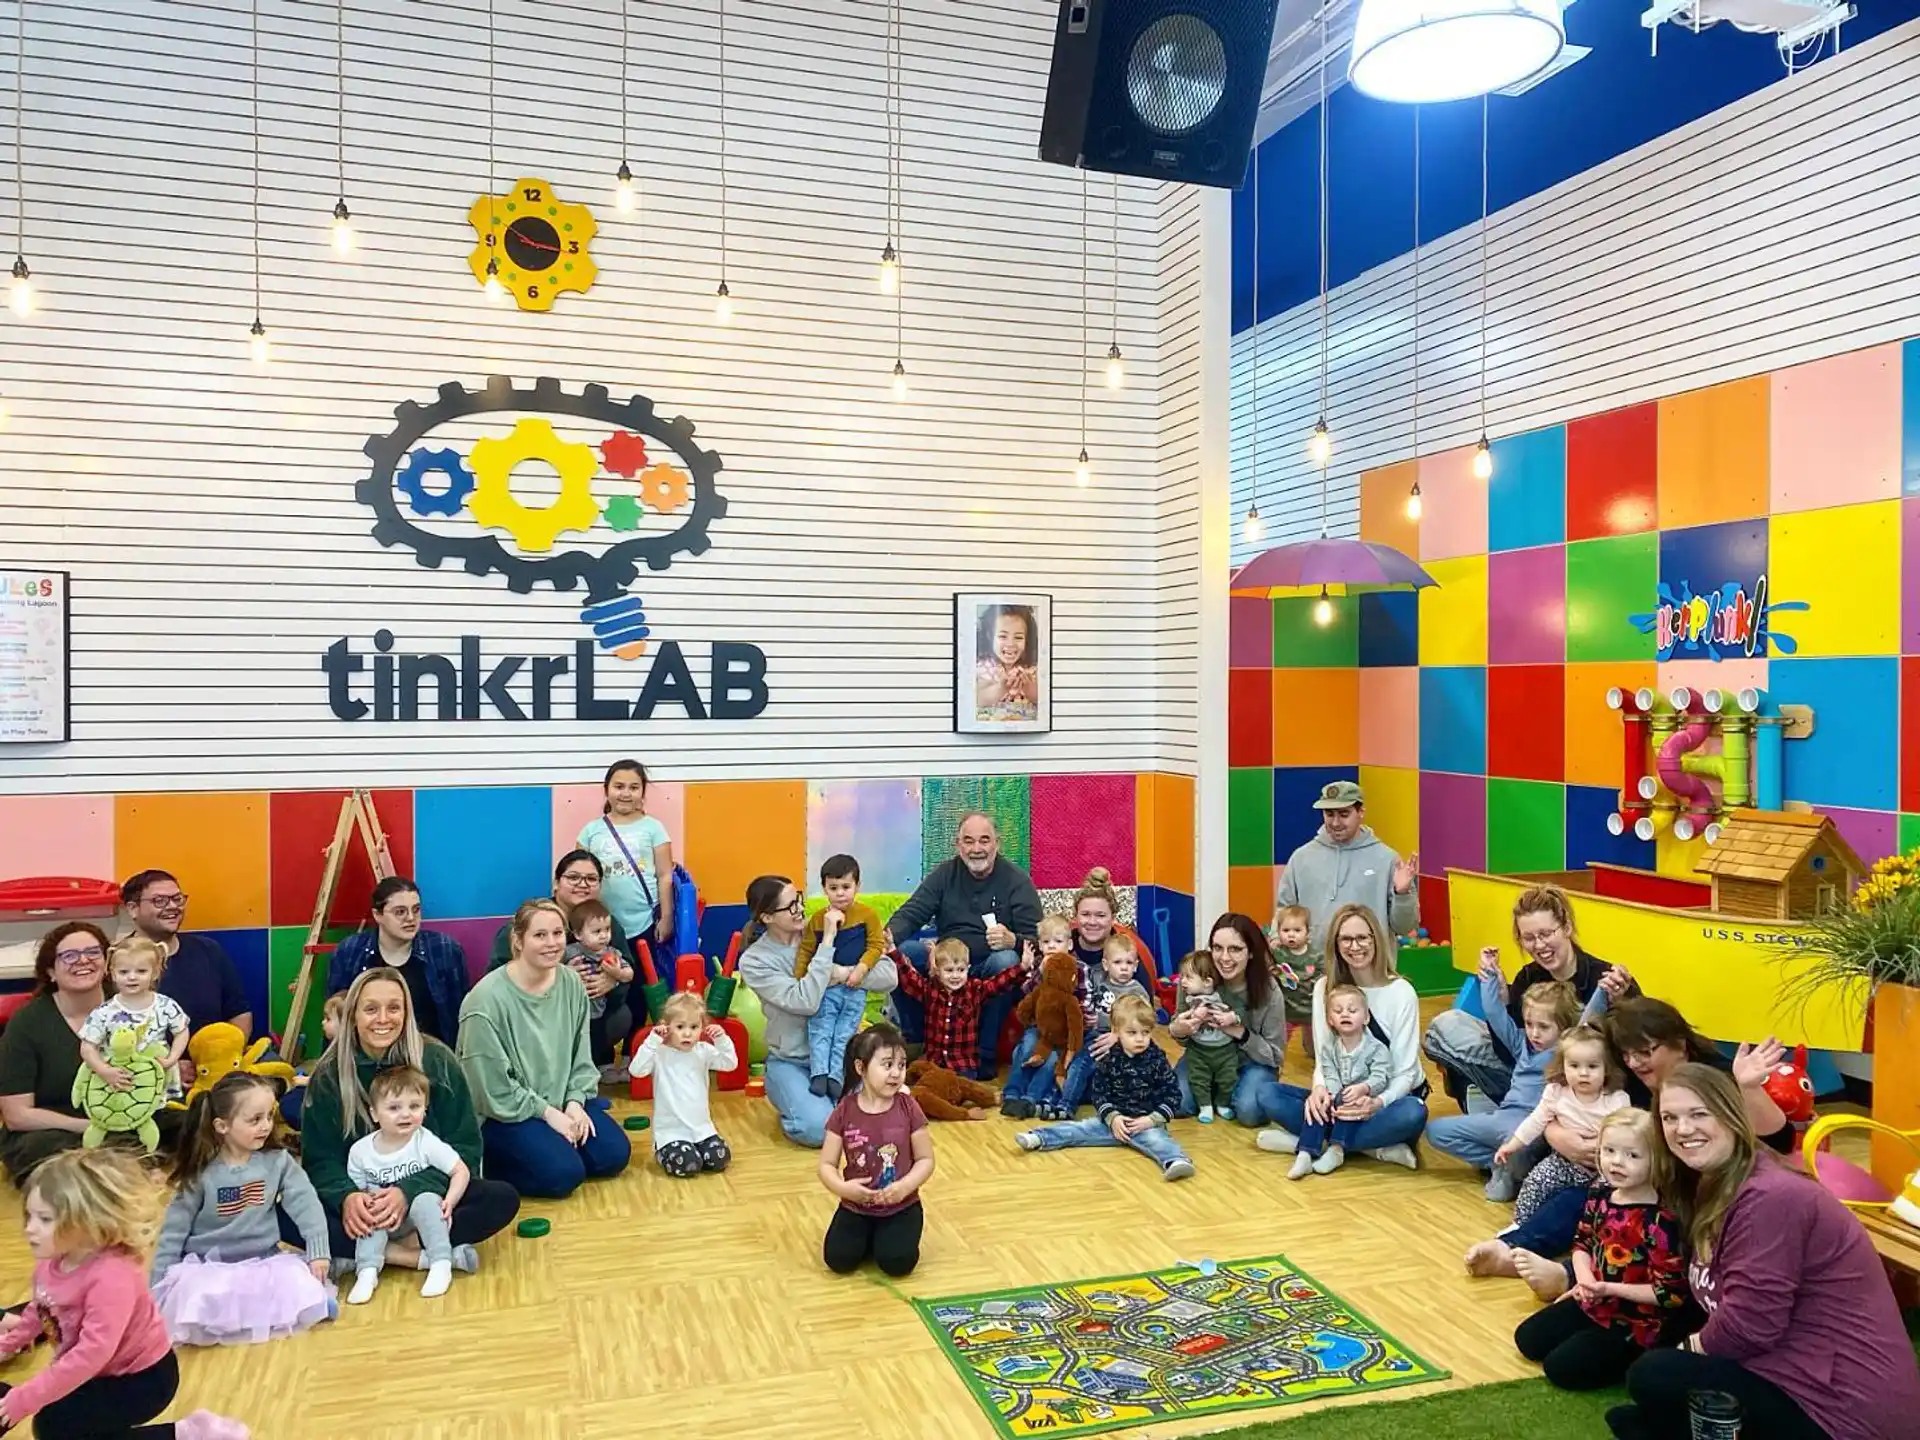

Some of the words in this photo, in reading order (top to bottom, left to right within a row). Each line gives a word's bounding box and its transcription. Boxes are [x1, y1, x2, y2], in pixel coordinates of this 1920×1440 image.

[523, 188, 541, 202] 12
[485, 234, 496, 247] 9
[568, 241, 579, 254] 3
[527, 286, 538, 298] 6
[322, 628, 769, 721] tinkrLAB
